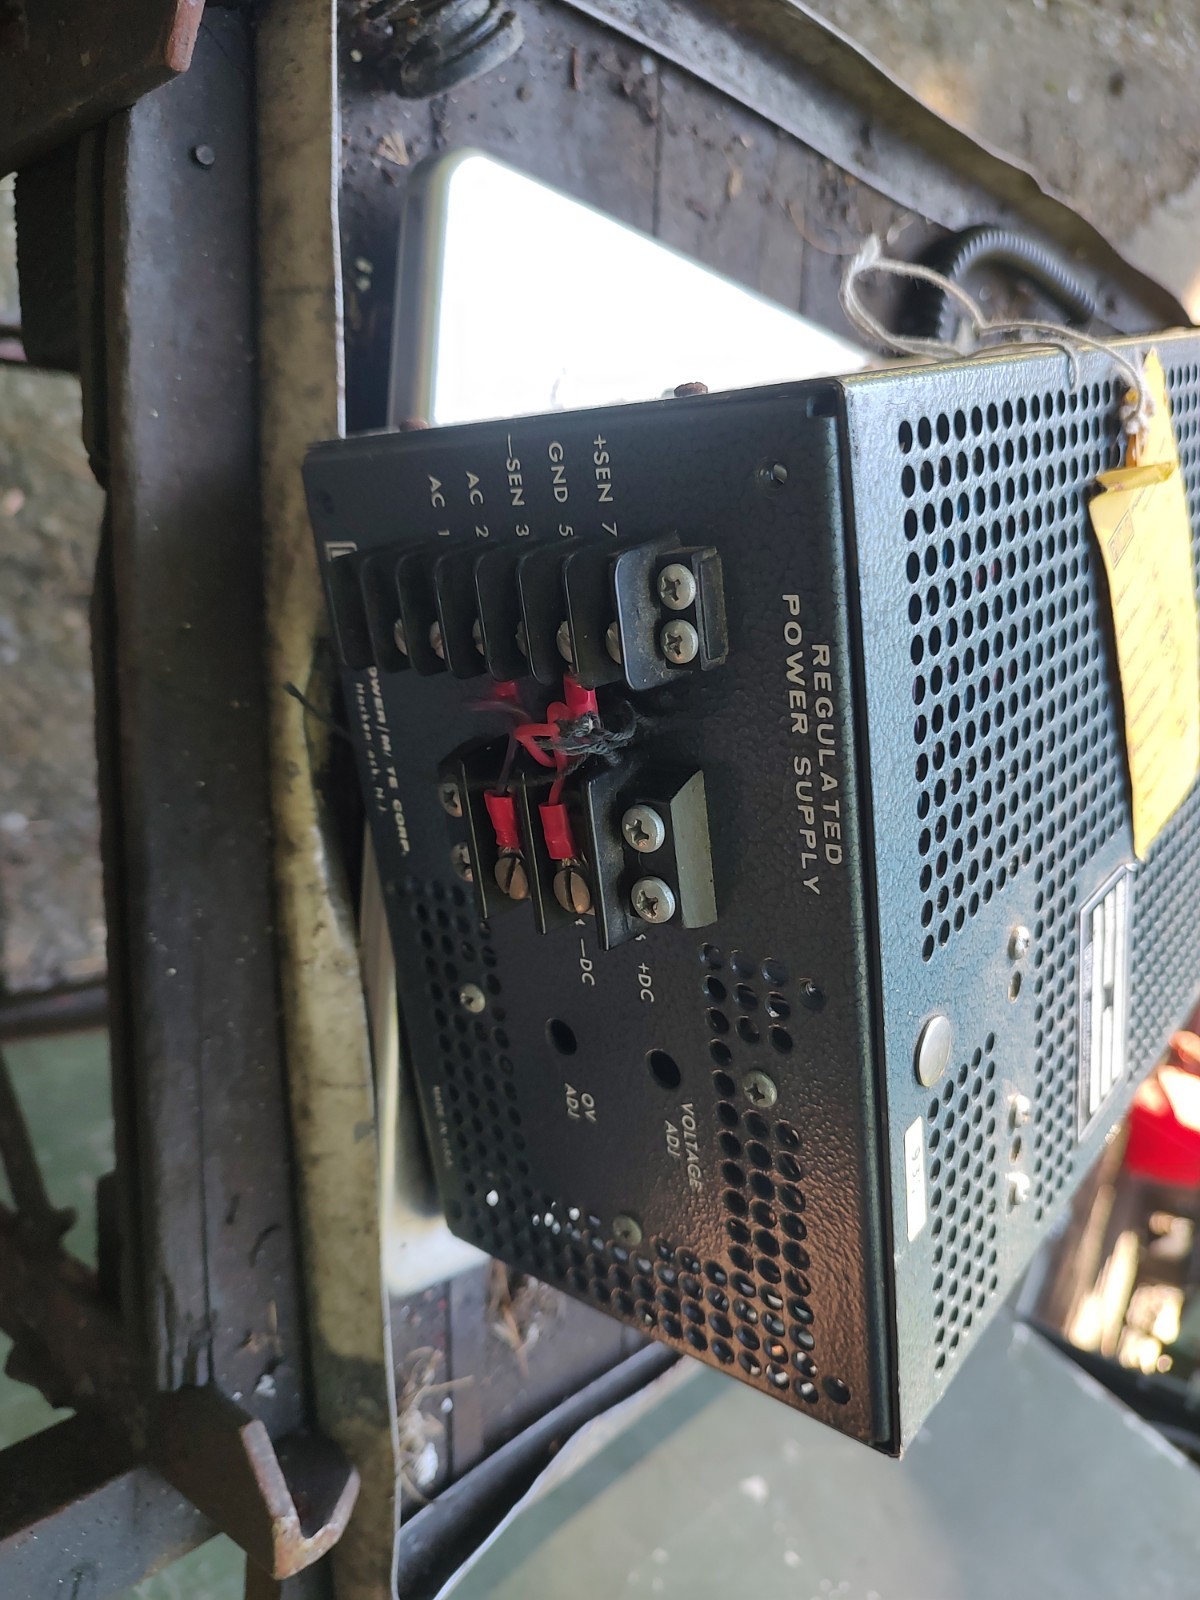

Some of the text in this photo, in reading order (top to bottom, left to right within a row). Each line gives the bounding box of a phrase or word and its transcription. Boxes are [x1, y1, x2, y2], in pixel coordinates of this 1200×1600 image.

[428, 474, 450, 537] AC 1
[465, 470, 489, 538] AC 2
[549, 441, 573, 537] GND 5
[594, 434, 618, 538] +SEN 7
[515, 524, 529, 537] 3
[782, 594, 821, 896] POWER SUPPLY
[811, 643, 843, 866] REGULATED
[638, 962, 655, 1003] +DC
[564, 1083, 580, 1118] ADJ
[581, 1093, 597, 1122] OV
[664, 1120, 680, 1157] ADJ
[681, 1103, 704, 1191] VOLTAGE
